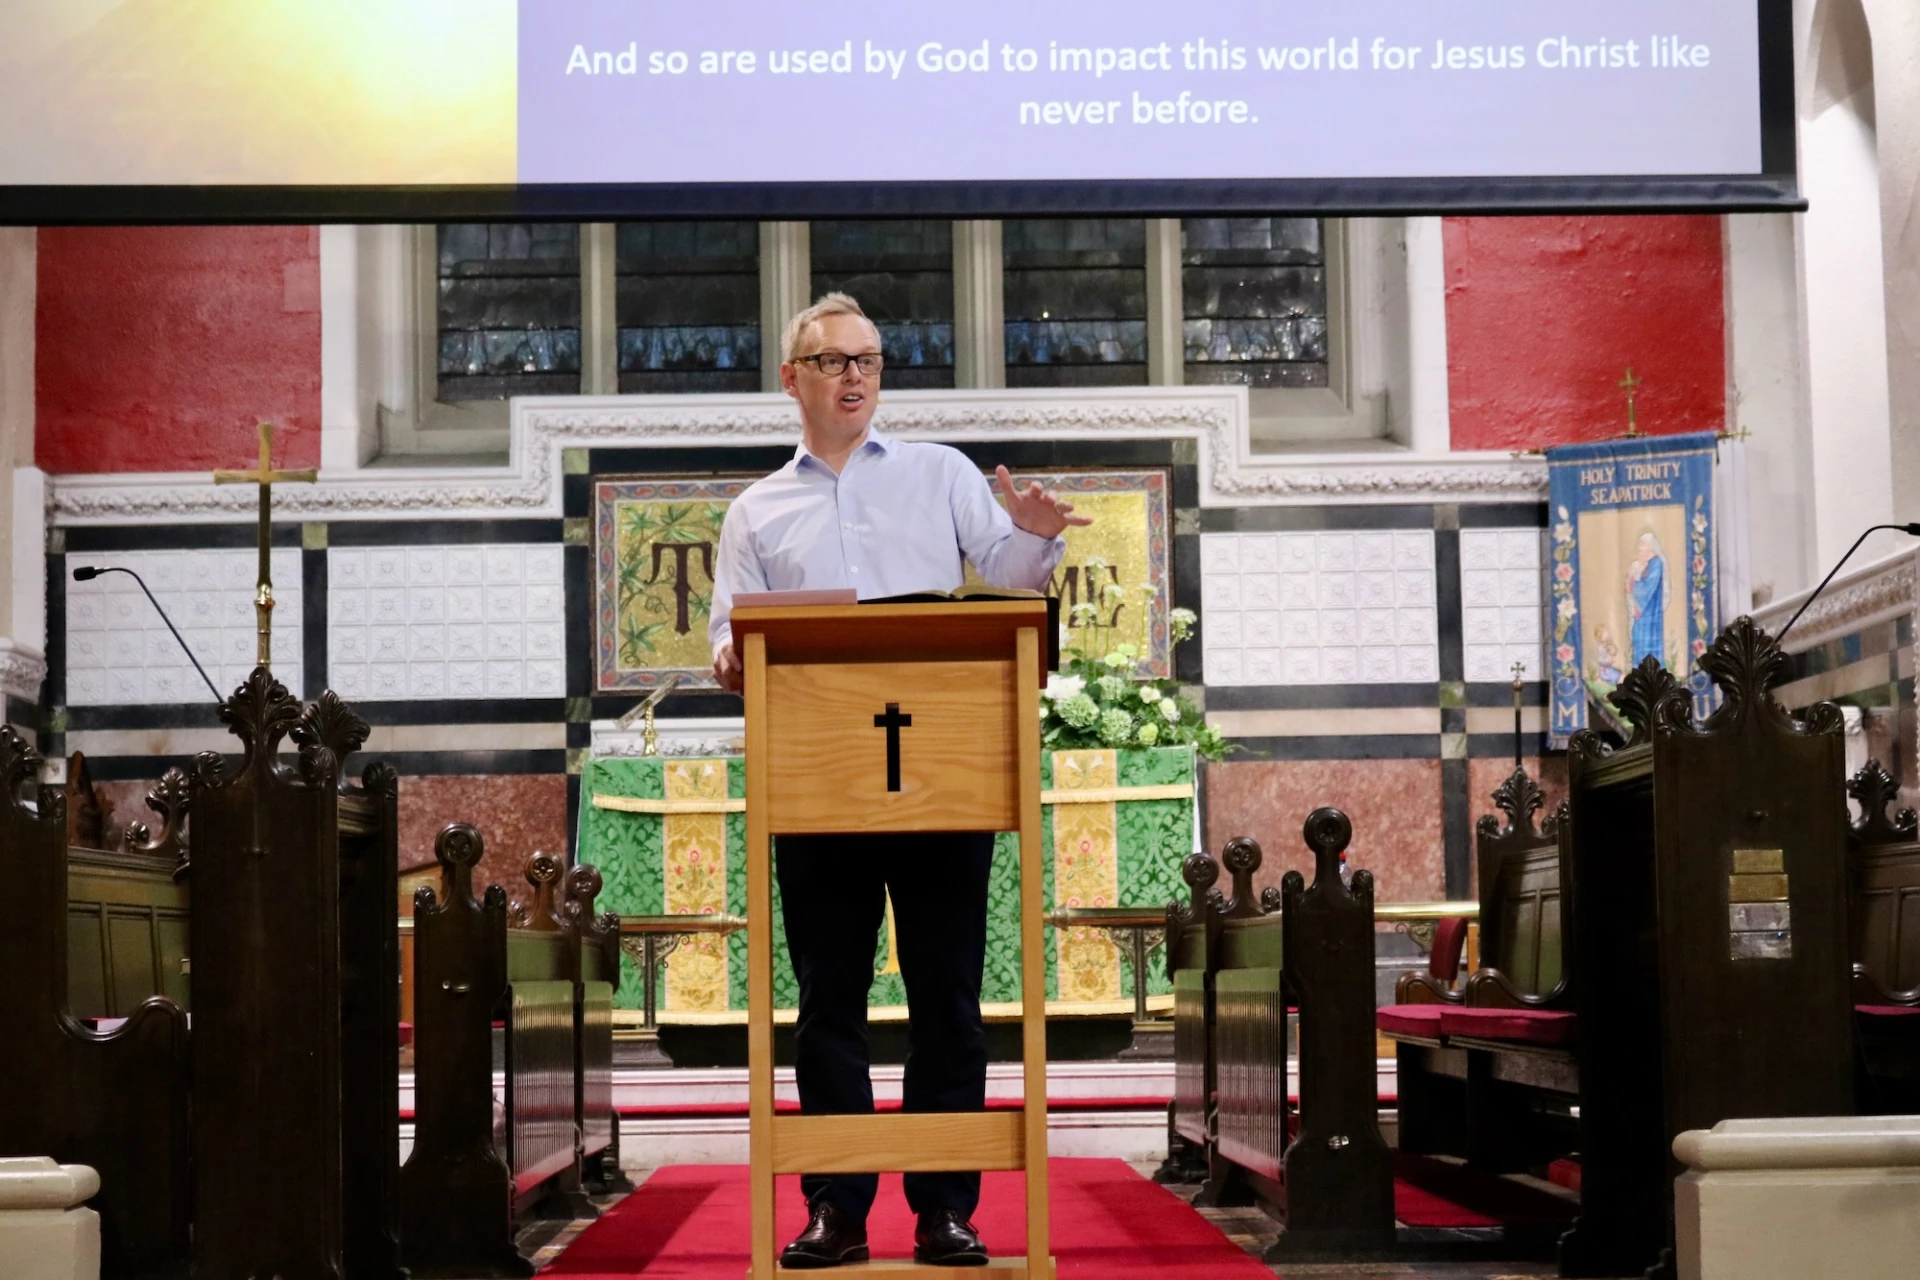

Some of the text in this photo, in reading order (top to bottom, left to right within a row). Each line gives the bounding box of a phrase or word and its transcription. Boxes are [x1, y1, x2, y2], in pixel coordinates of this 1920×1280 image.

[566, 35, 1710, 80] And so are used by God to impact this world for Jesus Christ like
[1019, 91, 1259, 125] never before.
[1580, 461, 1681, 486] HOLY TRINITY
[1590, 483, 1671, 505] SEAPATRICK
[1557, 702, 1578, 728] M
